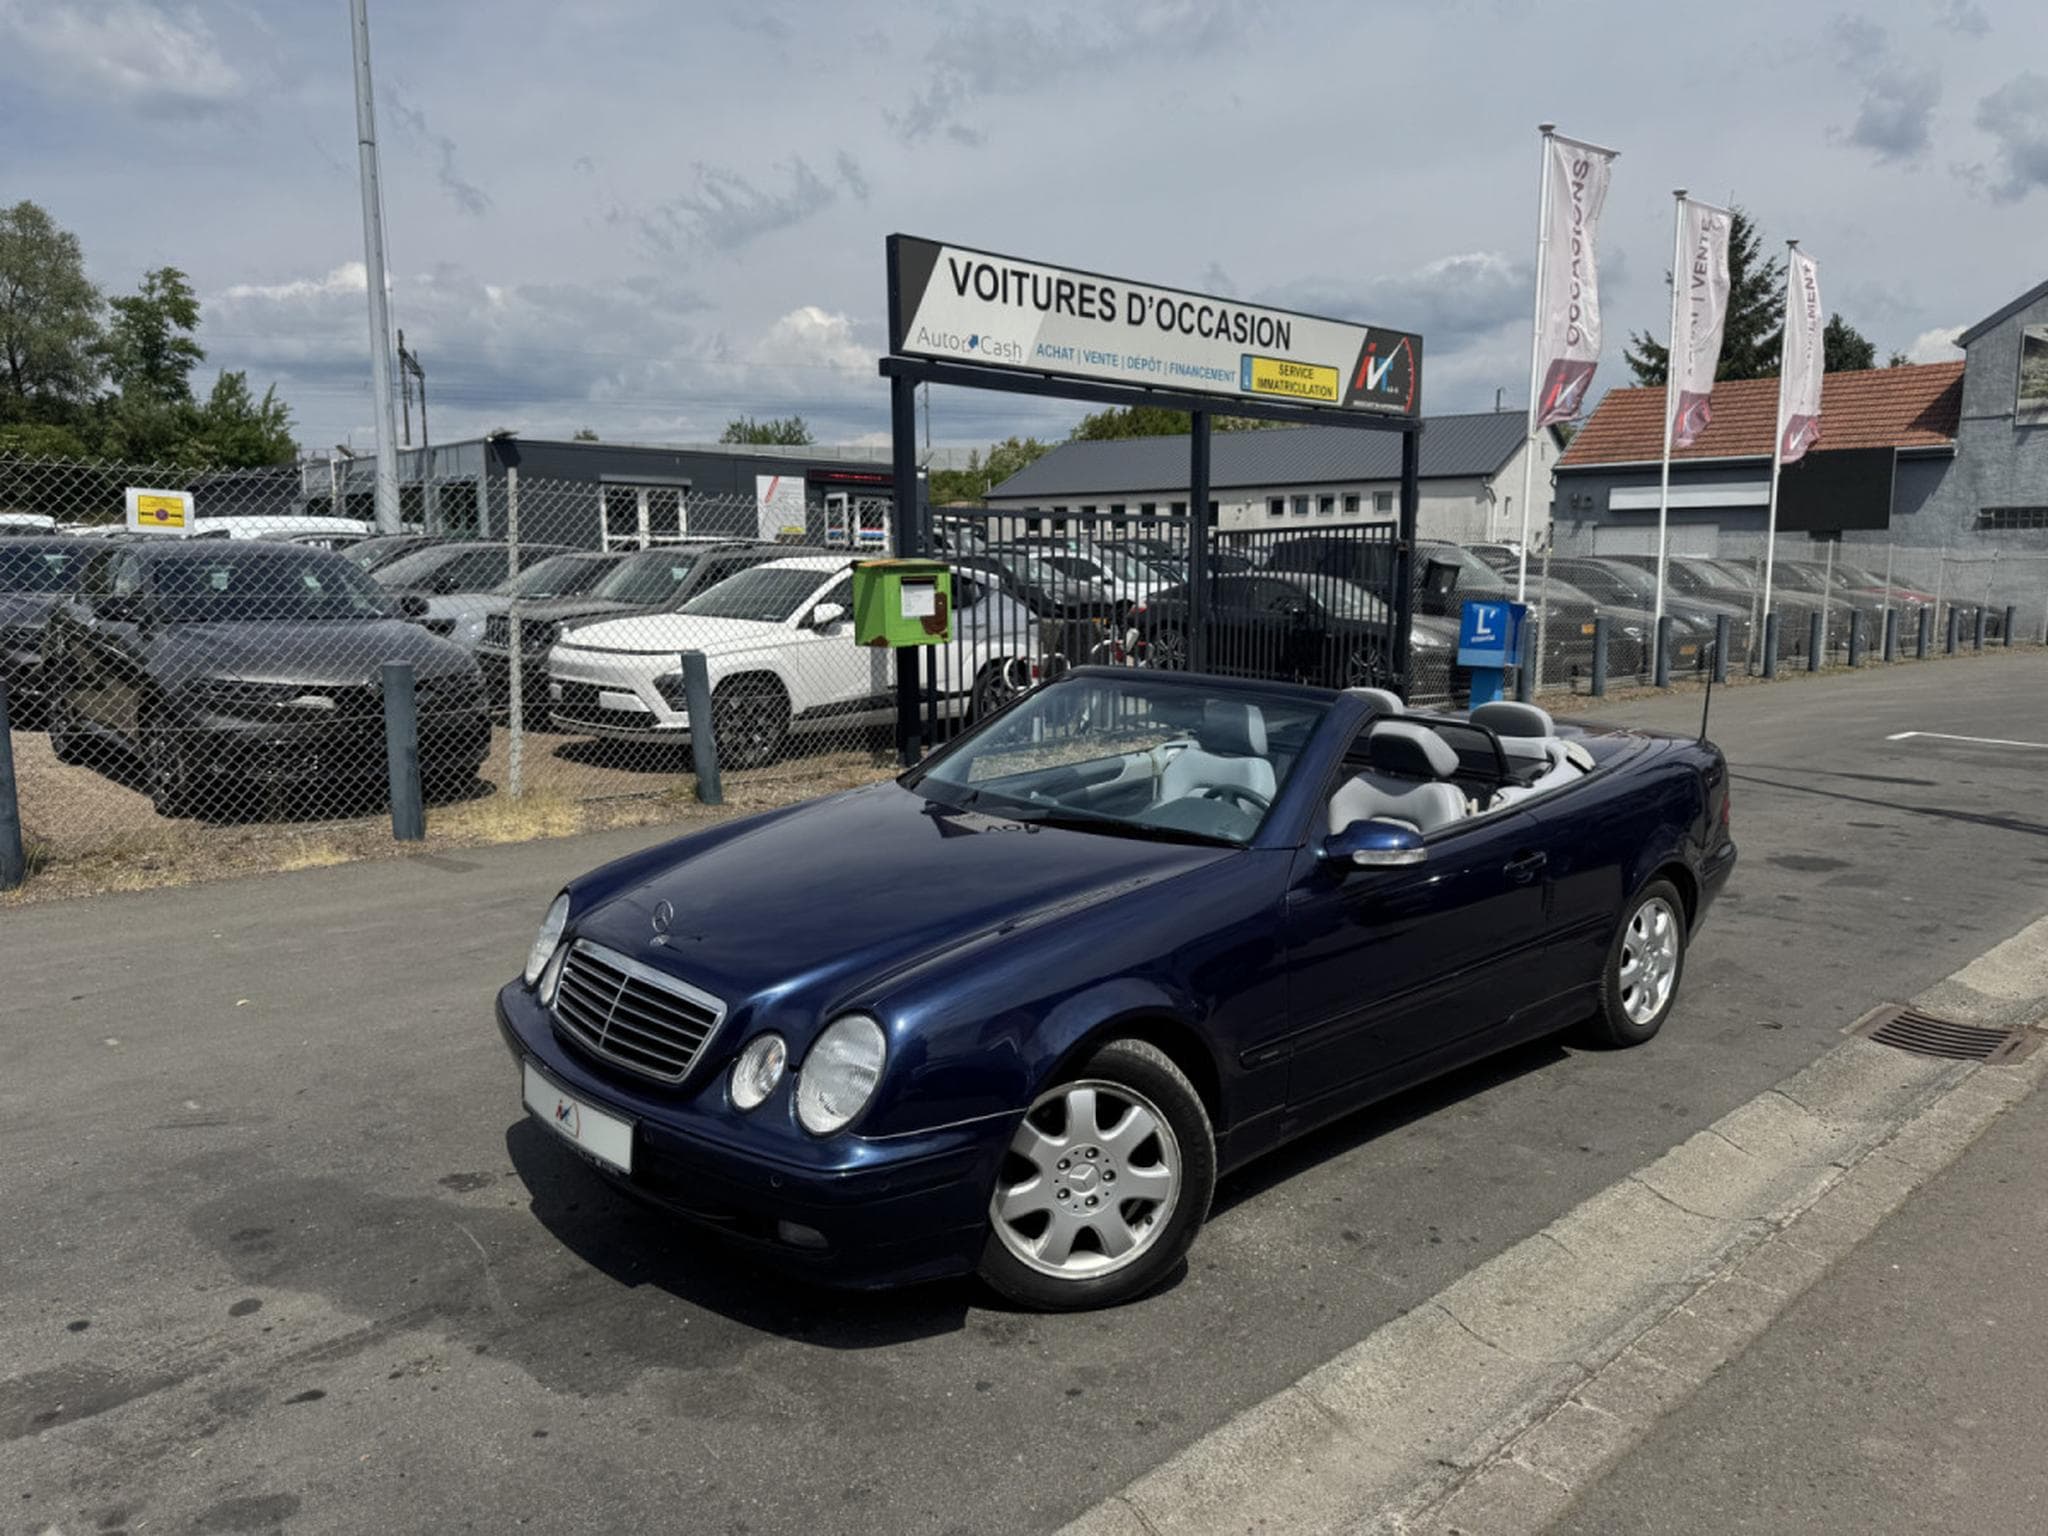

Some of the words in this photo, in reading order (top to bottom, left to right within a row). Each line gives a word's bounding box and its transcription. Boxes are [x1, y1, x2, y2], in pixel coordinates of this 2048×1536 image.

[948, 257, 1117, 323] VOITURES
[1127, 292, 1291, 351] D'OCCASION
[980, 335, 1022, 360] Cash
[1036, 343, 1075, 361] ACHAT
[1083, 350, 1119, 367] VENTE
[1169, 362, 1236, 382] FINANCEMENT
[1278, 363, 1315, 380] SERVICE
[1256, 377, 1334, 397] IMMATRICULATION
